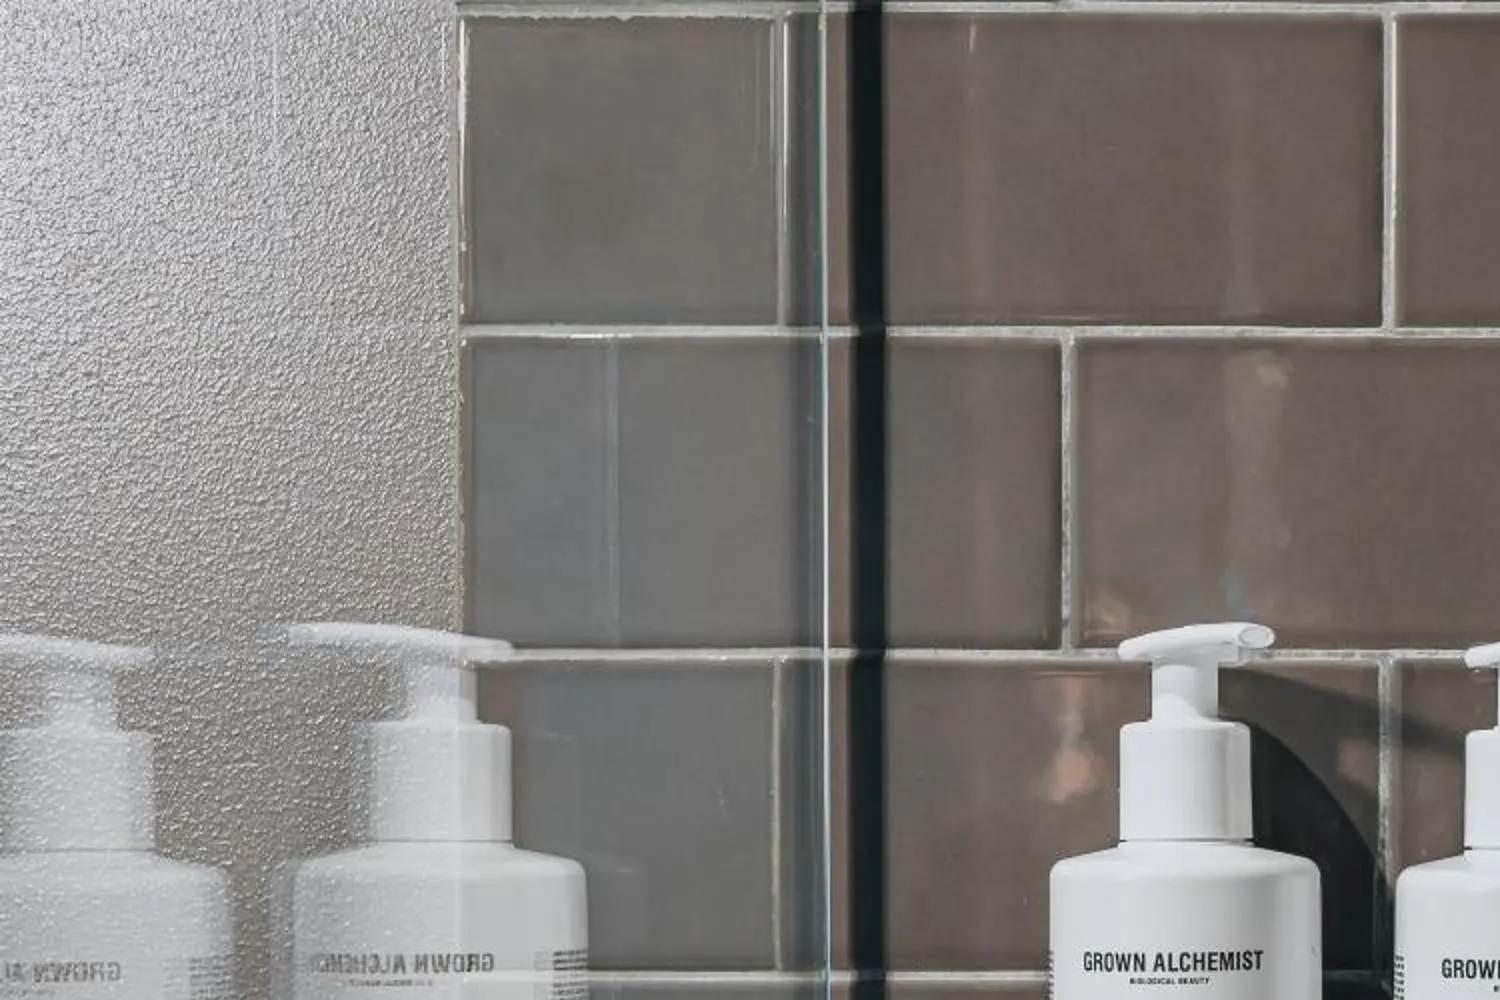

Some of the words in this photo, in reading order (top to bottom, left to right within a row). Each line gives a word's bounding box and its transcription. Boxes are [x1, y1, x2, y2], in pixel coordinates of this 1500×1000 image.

[1083, 950, 1146, 972] GROWN
[1152, 949, 1264, 972] ALCHEMIST
[1129, 977, 1175, 985] BIOLOGICAL
[1177, 977, 1210, 985] BEAUTY
